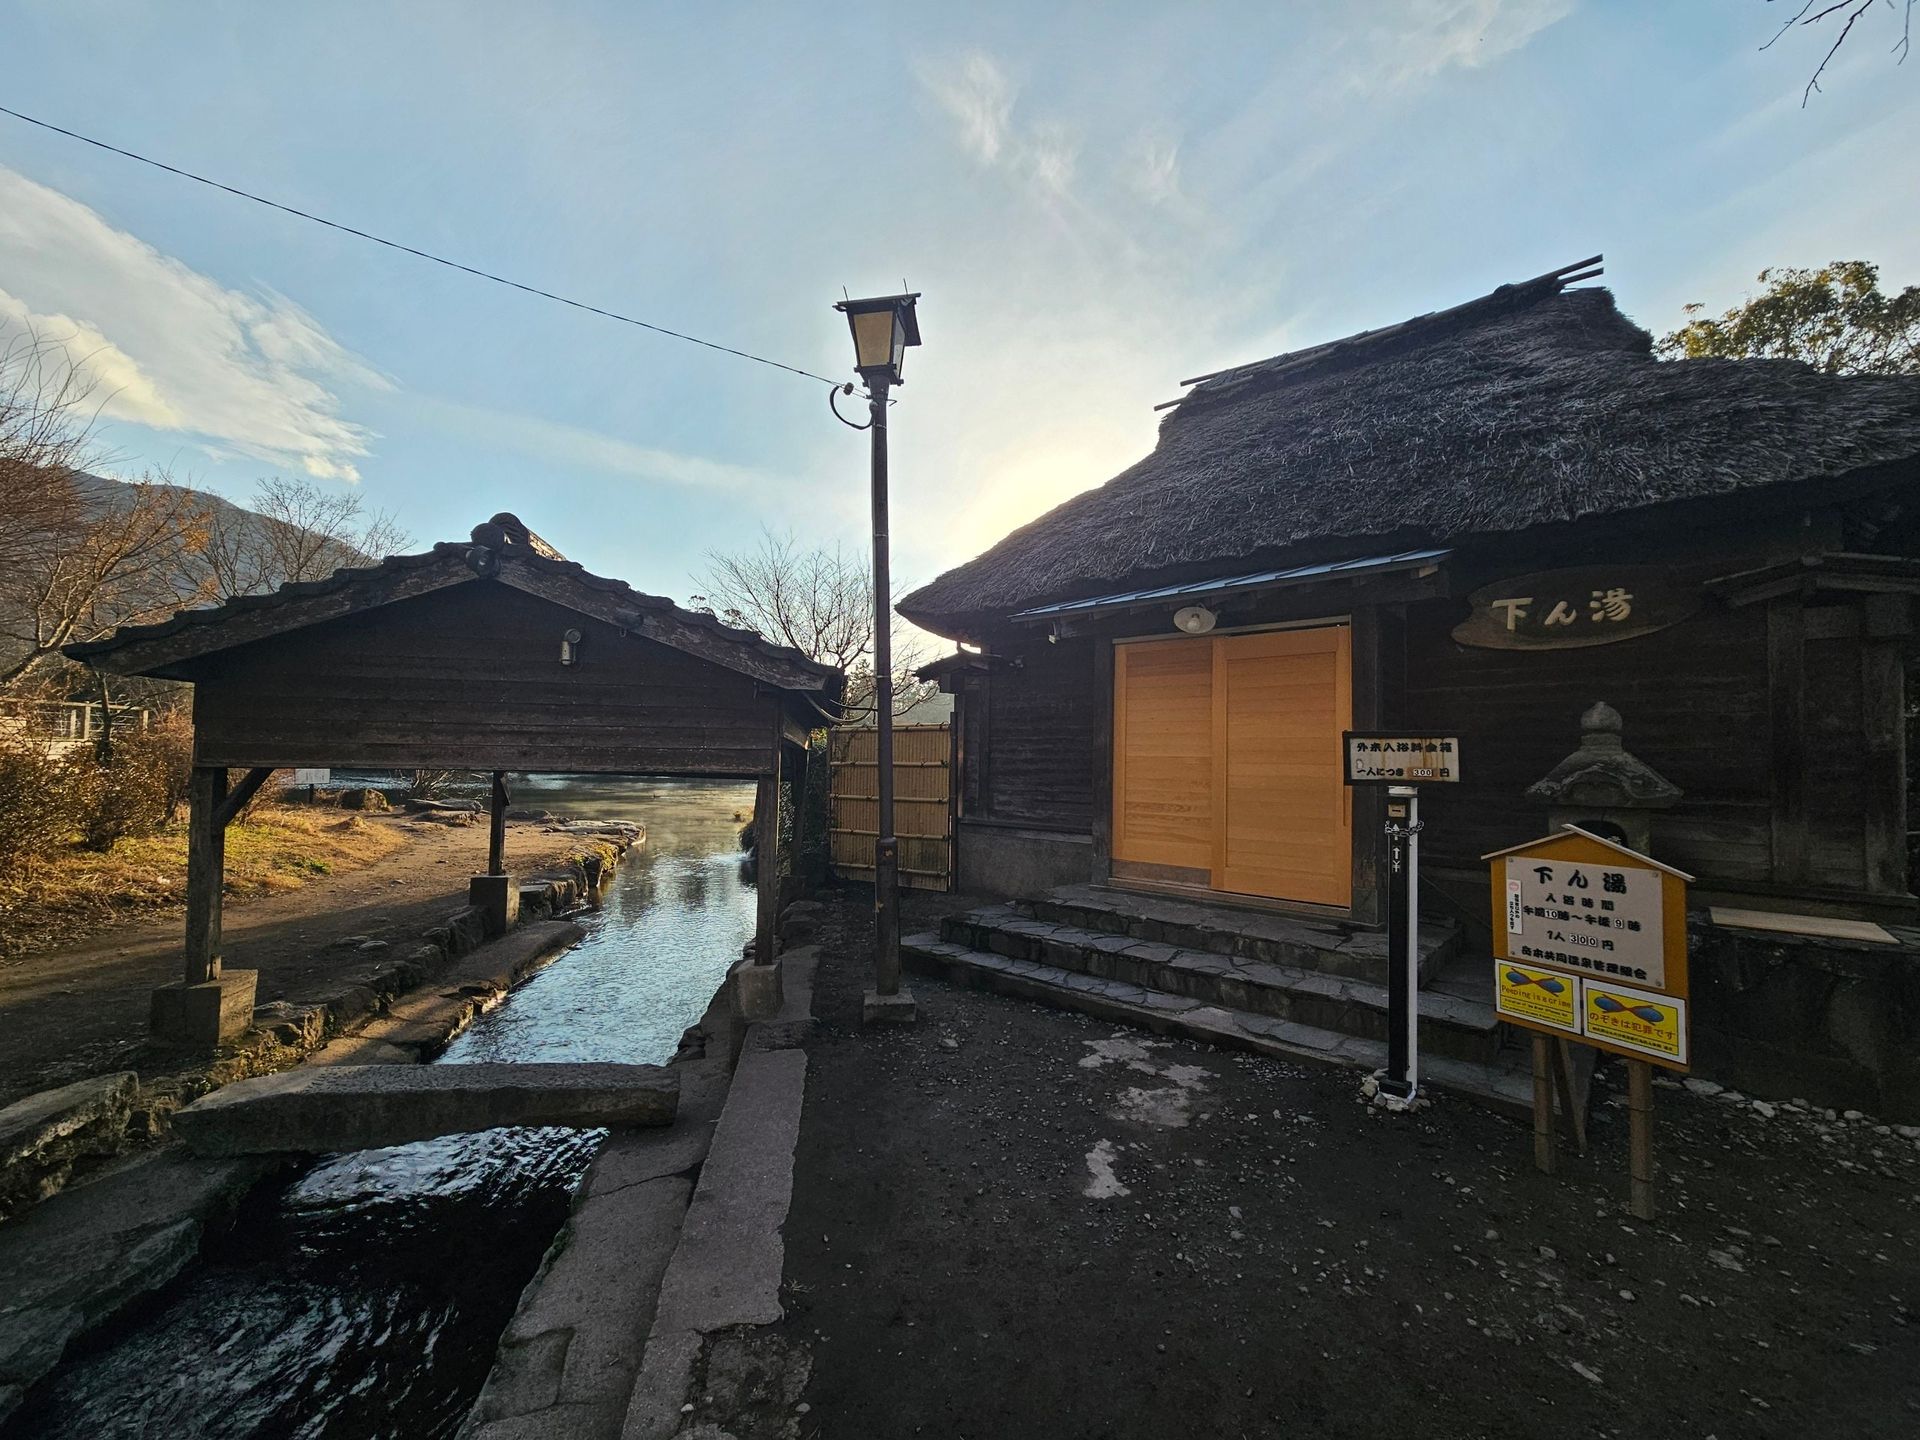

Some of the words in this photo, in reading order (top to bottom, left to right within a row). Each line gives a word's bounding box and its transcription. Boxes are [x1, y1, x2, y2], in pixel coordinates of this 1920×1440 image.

[1492, 588, 1634, 631] 下ん湯
[1533, 866, 1627, 894] 下ん湯
[1545, 893, 1615, 911] 入浴時間
[1502, 985, 1531, 999] Peeping
[1548, 998, 1571, 1008] crime
[1590, 1012, 1675, 1040] のぞきは犯罪です
